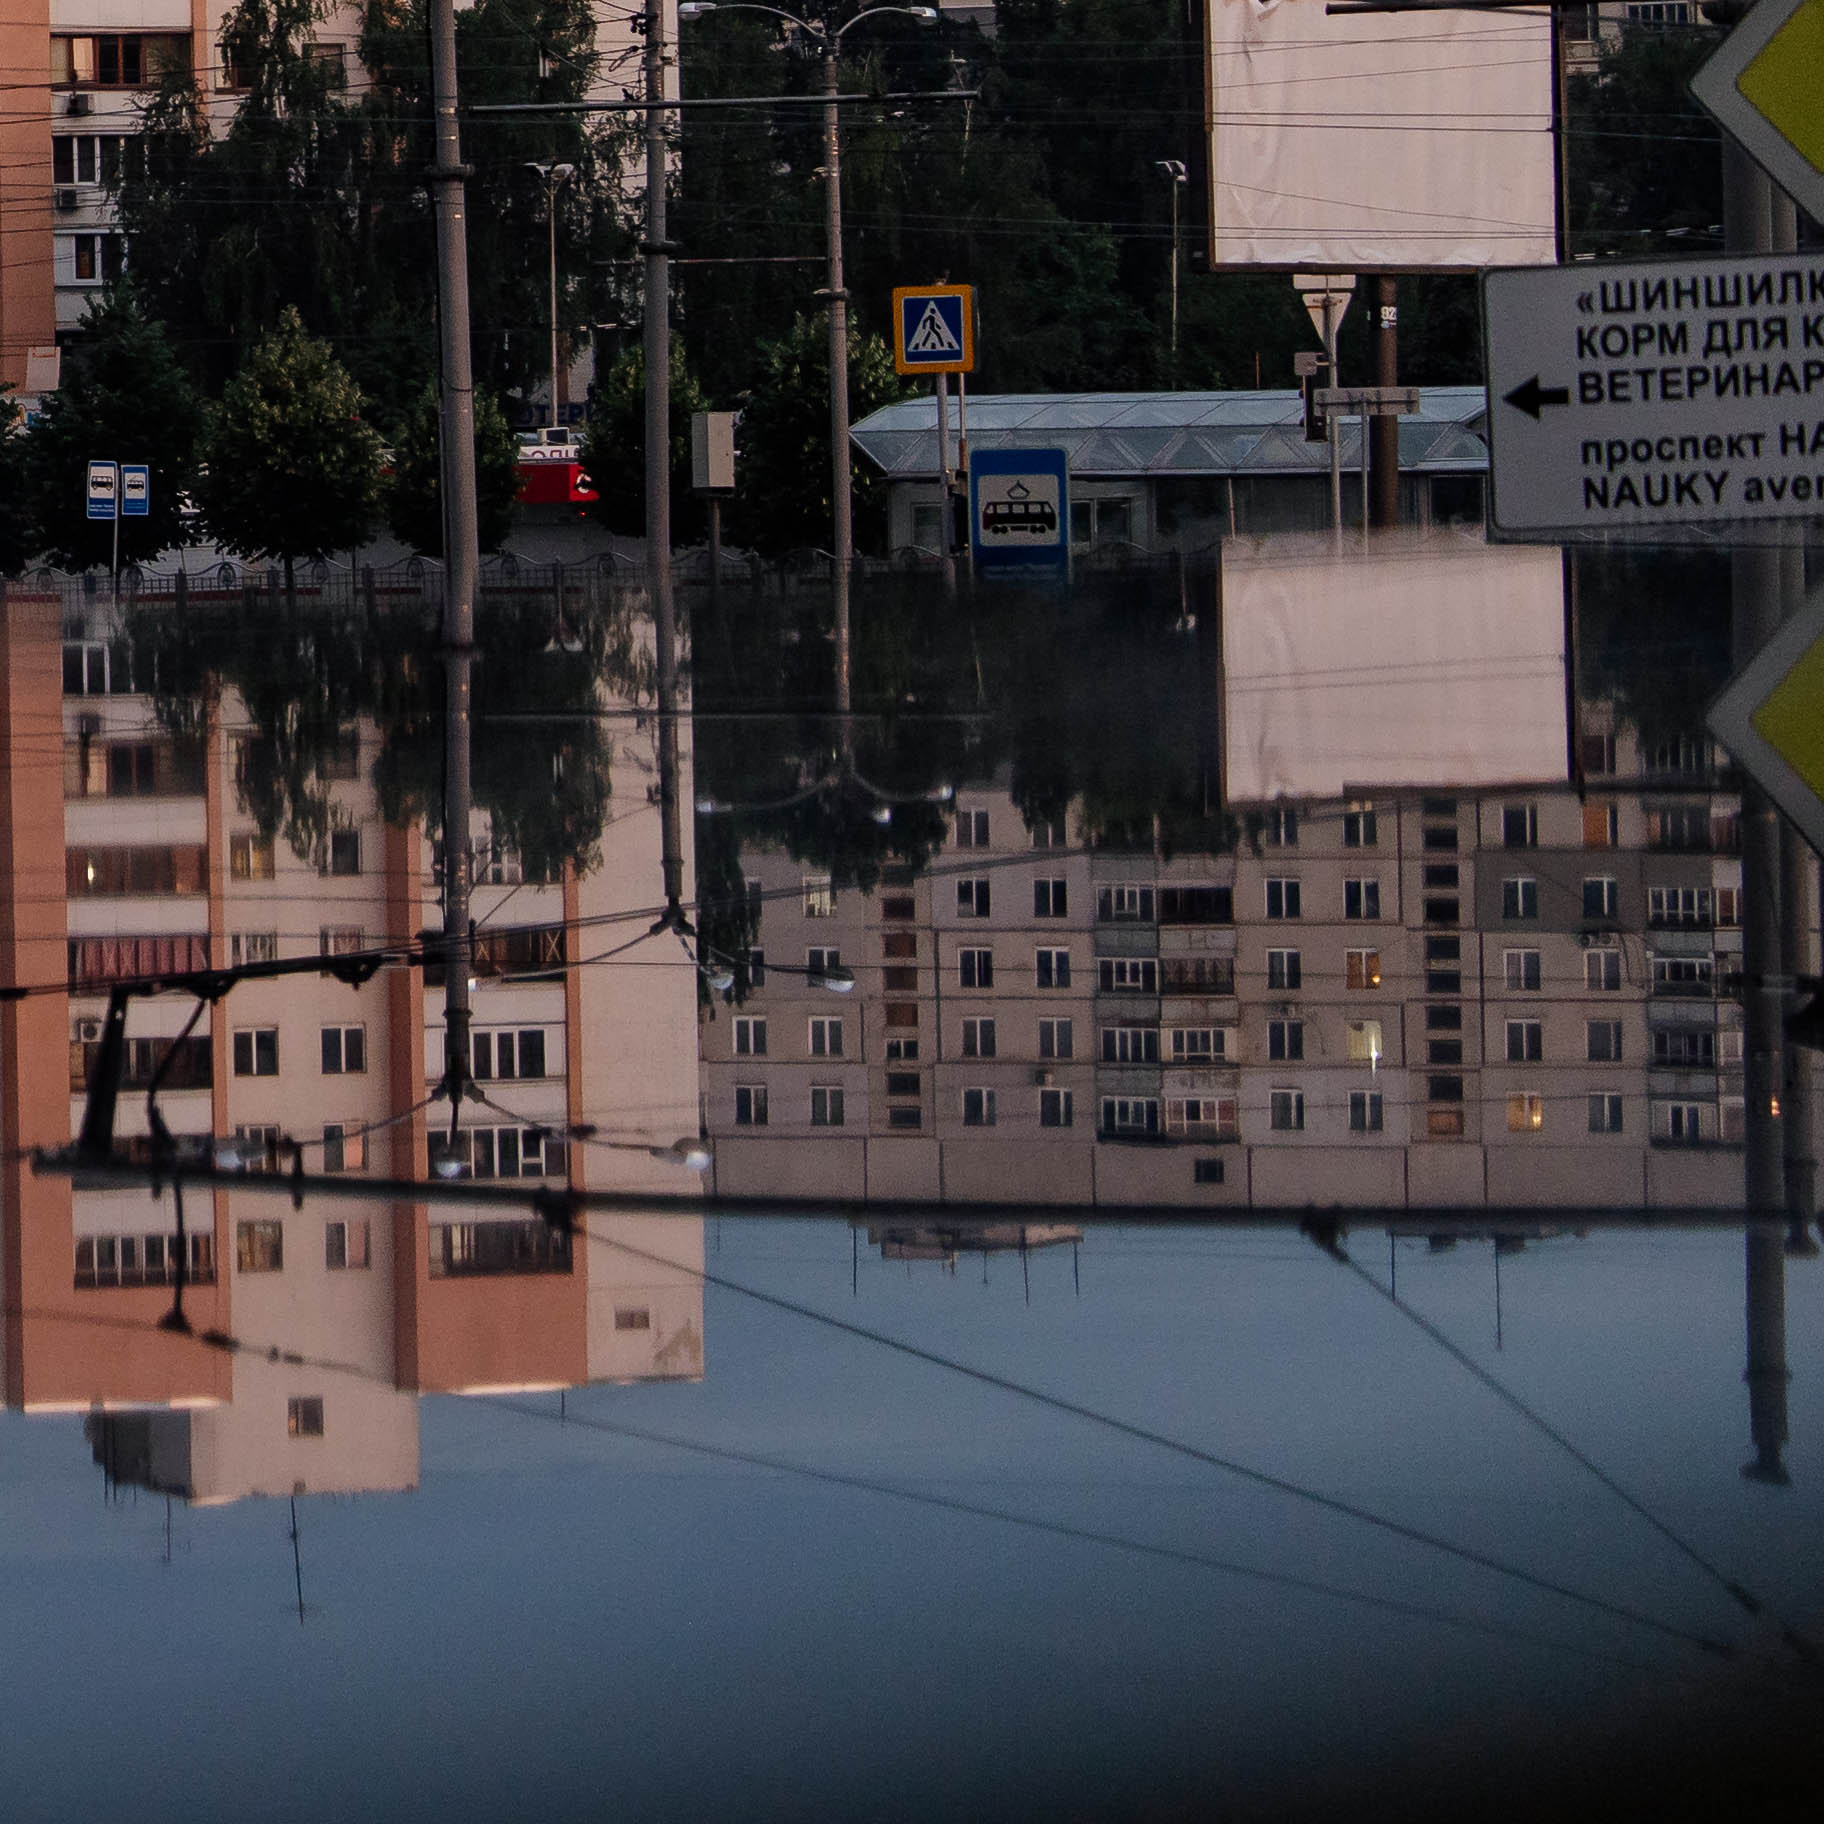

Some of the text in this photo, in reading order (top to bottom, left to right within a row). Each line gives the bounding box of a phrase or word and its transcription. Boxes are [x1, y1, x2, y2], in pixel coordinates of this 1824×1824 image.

[1576, 321, 1689, 360] КОРМ
[1703, 316, 1789, 360] ДЛЯ
[1578, 359, 1824, 404] ВЕТЕРИНАР
[1581, 432, 1767, 473] проспект
[1583, 470, 1730, 510] NAUKY
